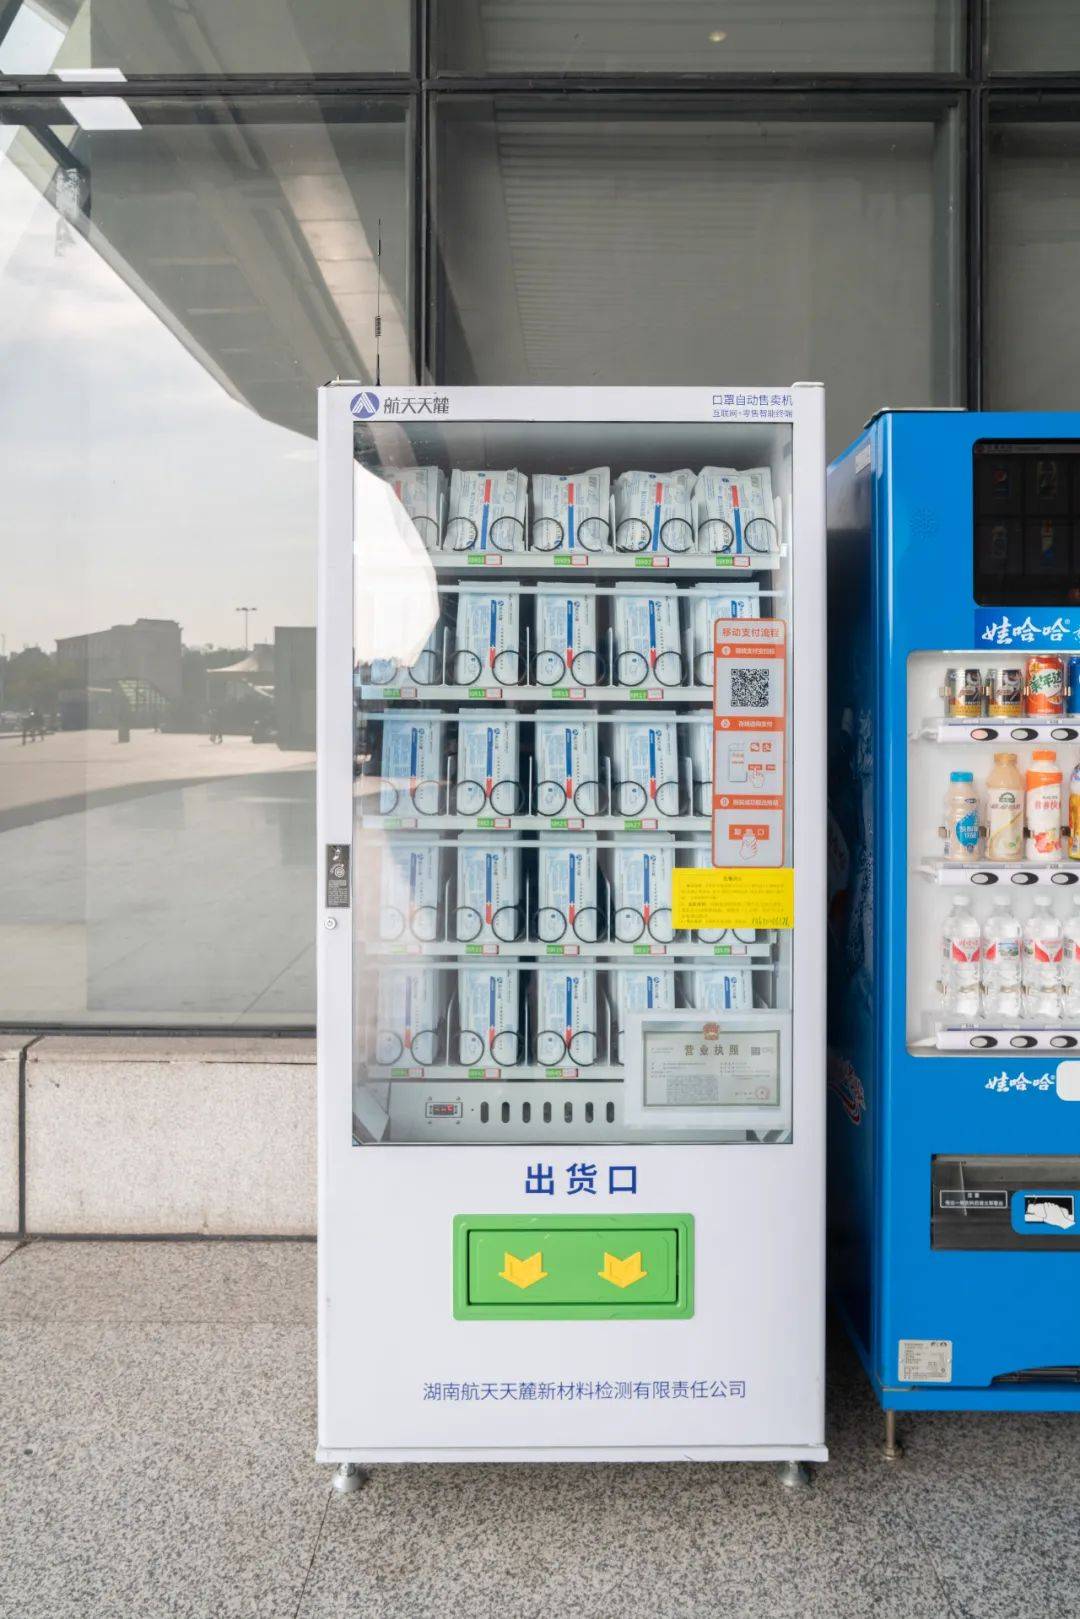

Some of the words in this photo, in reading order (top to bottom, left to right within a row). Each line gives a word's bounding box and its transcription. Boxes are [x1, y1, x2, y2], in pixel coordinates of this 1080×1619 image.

[383, 396, 450, 414] 航天天麓
[712, 394, 793, 406] 口罩自动售卖机
[981, 615, 1070, 645] 娃哈哈
[684, 1044, 740, 1056] 营业执照
[984, 1071, 1056, 1092] 娃哈哈
[525, 1163, 637, 1195] 出货口
[422, 1380, 746, 1401] 湖南航天天麓新材料检测有限责任公司
